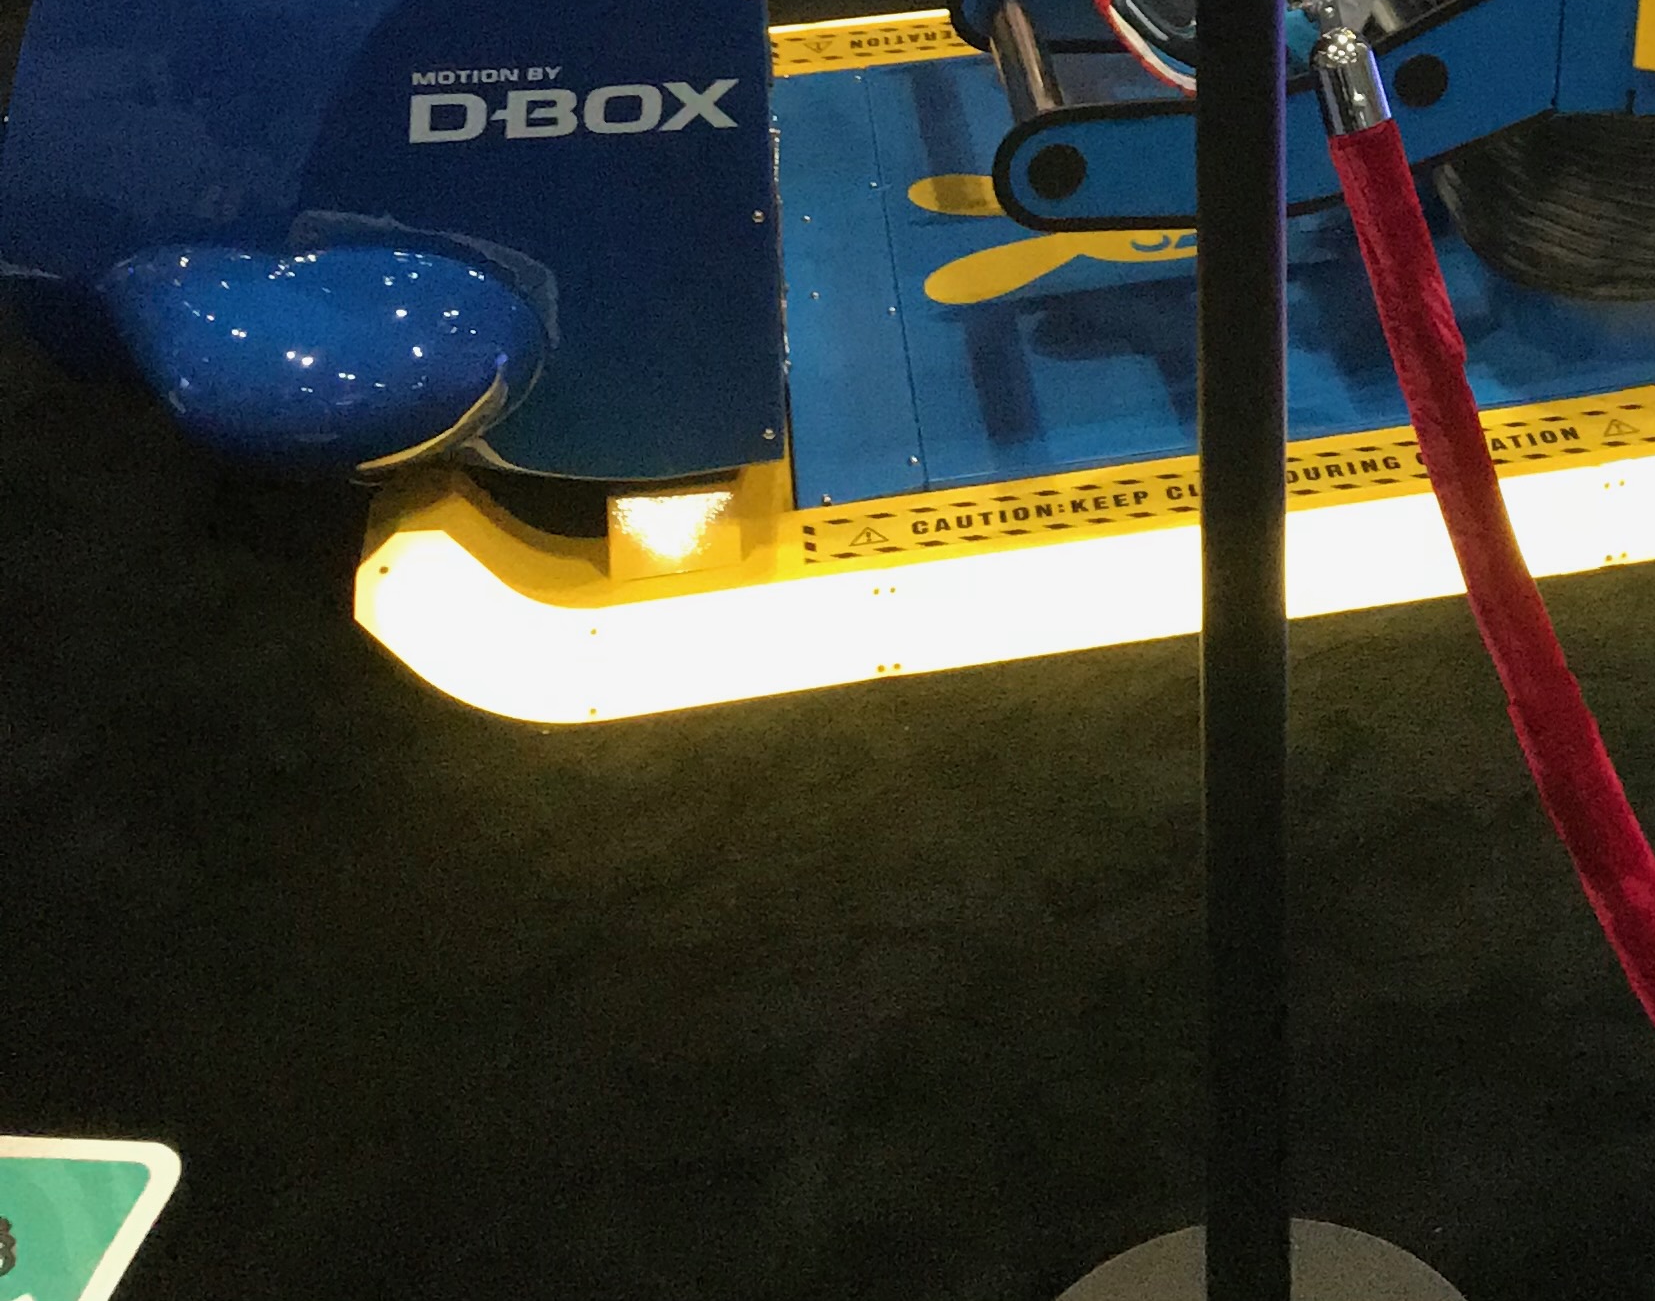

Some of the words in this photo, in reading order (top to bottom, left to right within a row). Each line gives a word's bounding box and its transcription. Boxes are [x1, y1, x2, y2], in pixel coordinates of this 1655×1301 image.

[411, 67, 519, 86] MOTION
[526, 65, 563, 81] BY
[409, 79, 739, 143] D-BOX
[1286, 454, 1401, 484] DURING
